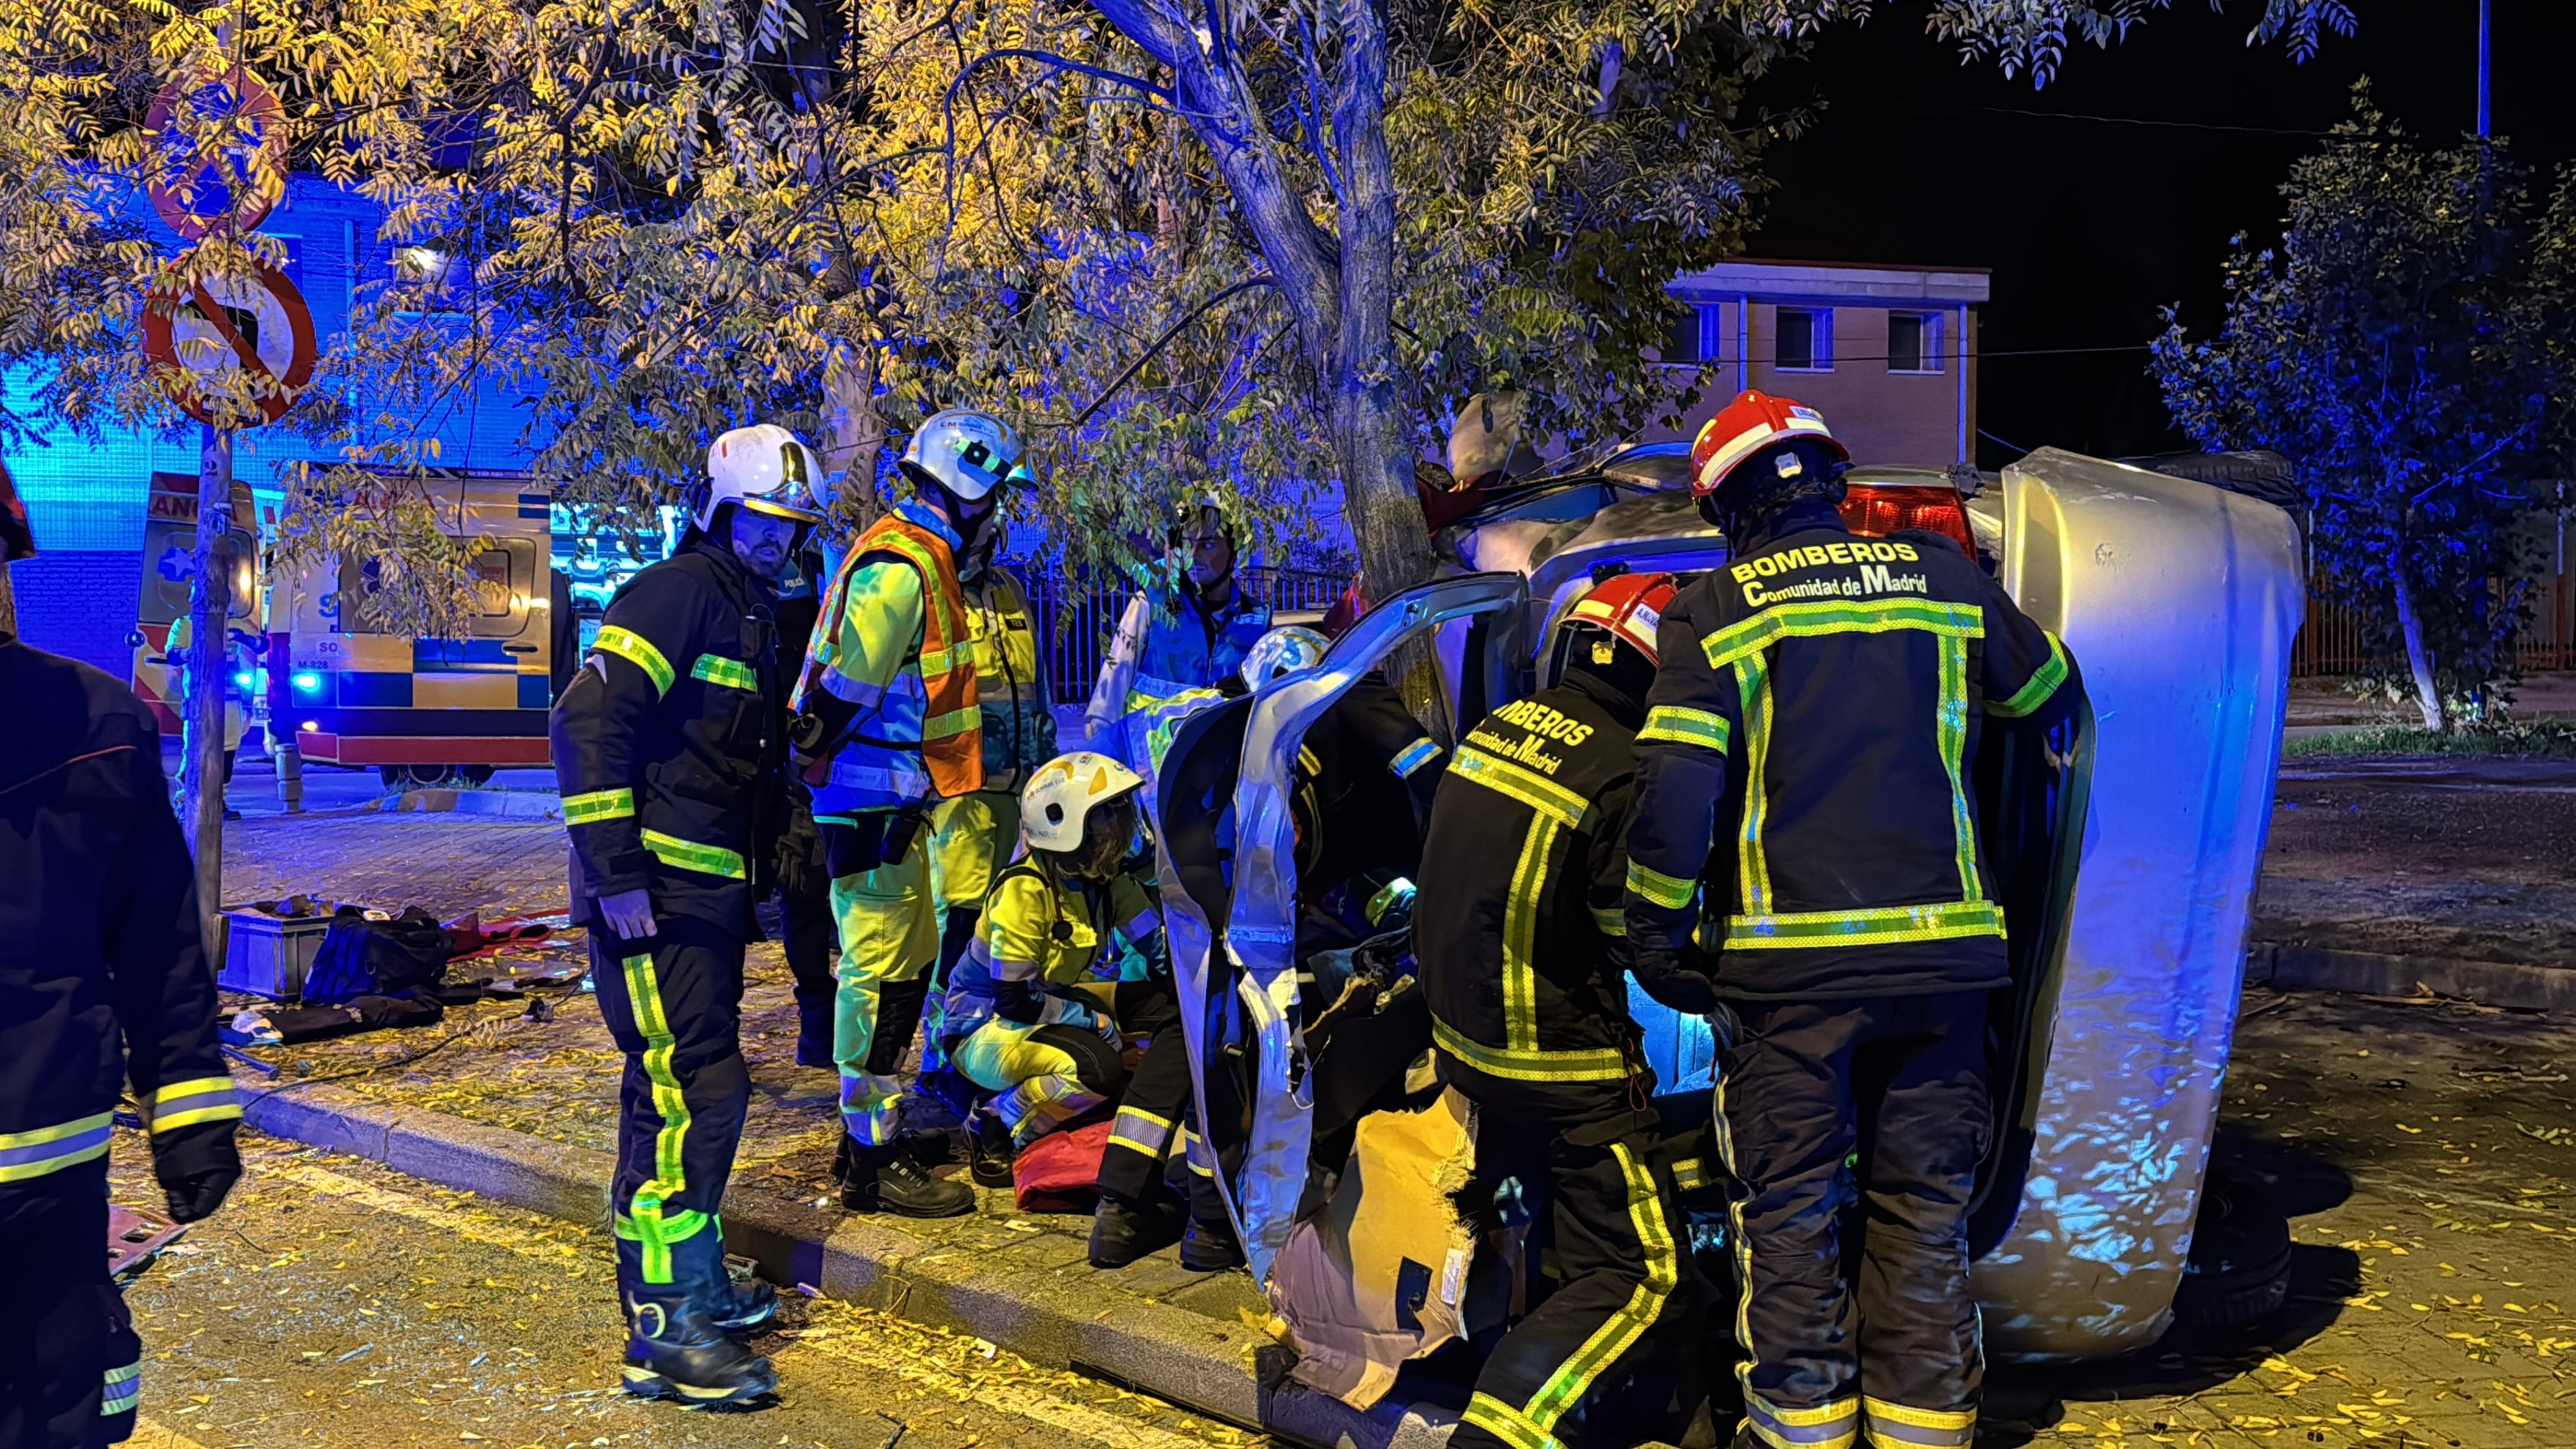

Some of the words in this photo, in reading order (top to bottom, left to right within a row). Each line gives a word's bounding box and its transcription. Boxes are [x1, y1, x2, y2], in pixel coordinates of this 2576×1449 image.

[1731, 543, 1919, 584] BOMBEROS
[1742, 577, 1842, 607] Comunidad
[1842, 577, 1862, 596] de
[1860, 564, 1928, 594] Madrid
[298, 661, 329, 670] M-828
[1491, 699, 1595, 746] MBEROS
[1502, 740, 1518, 757] de
[1513, 734, 1562, 776] Madrid
